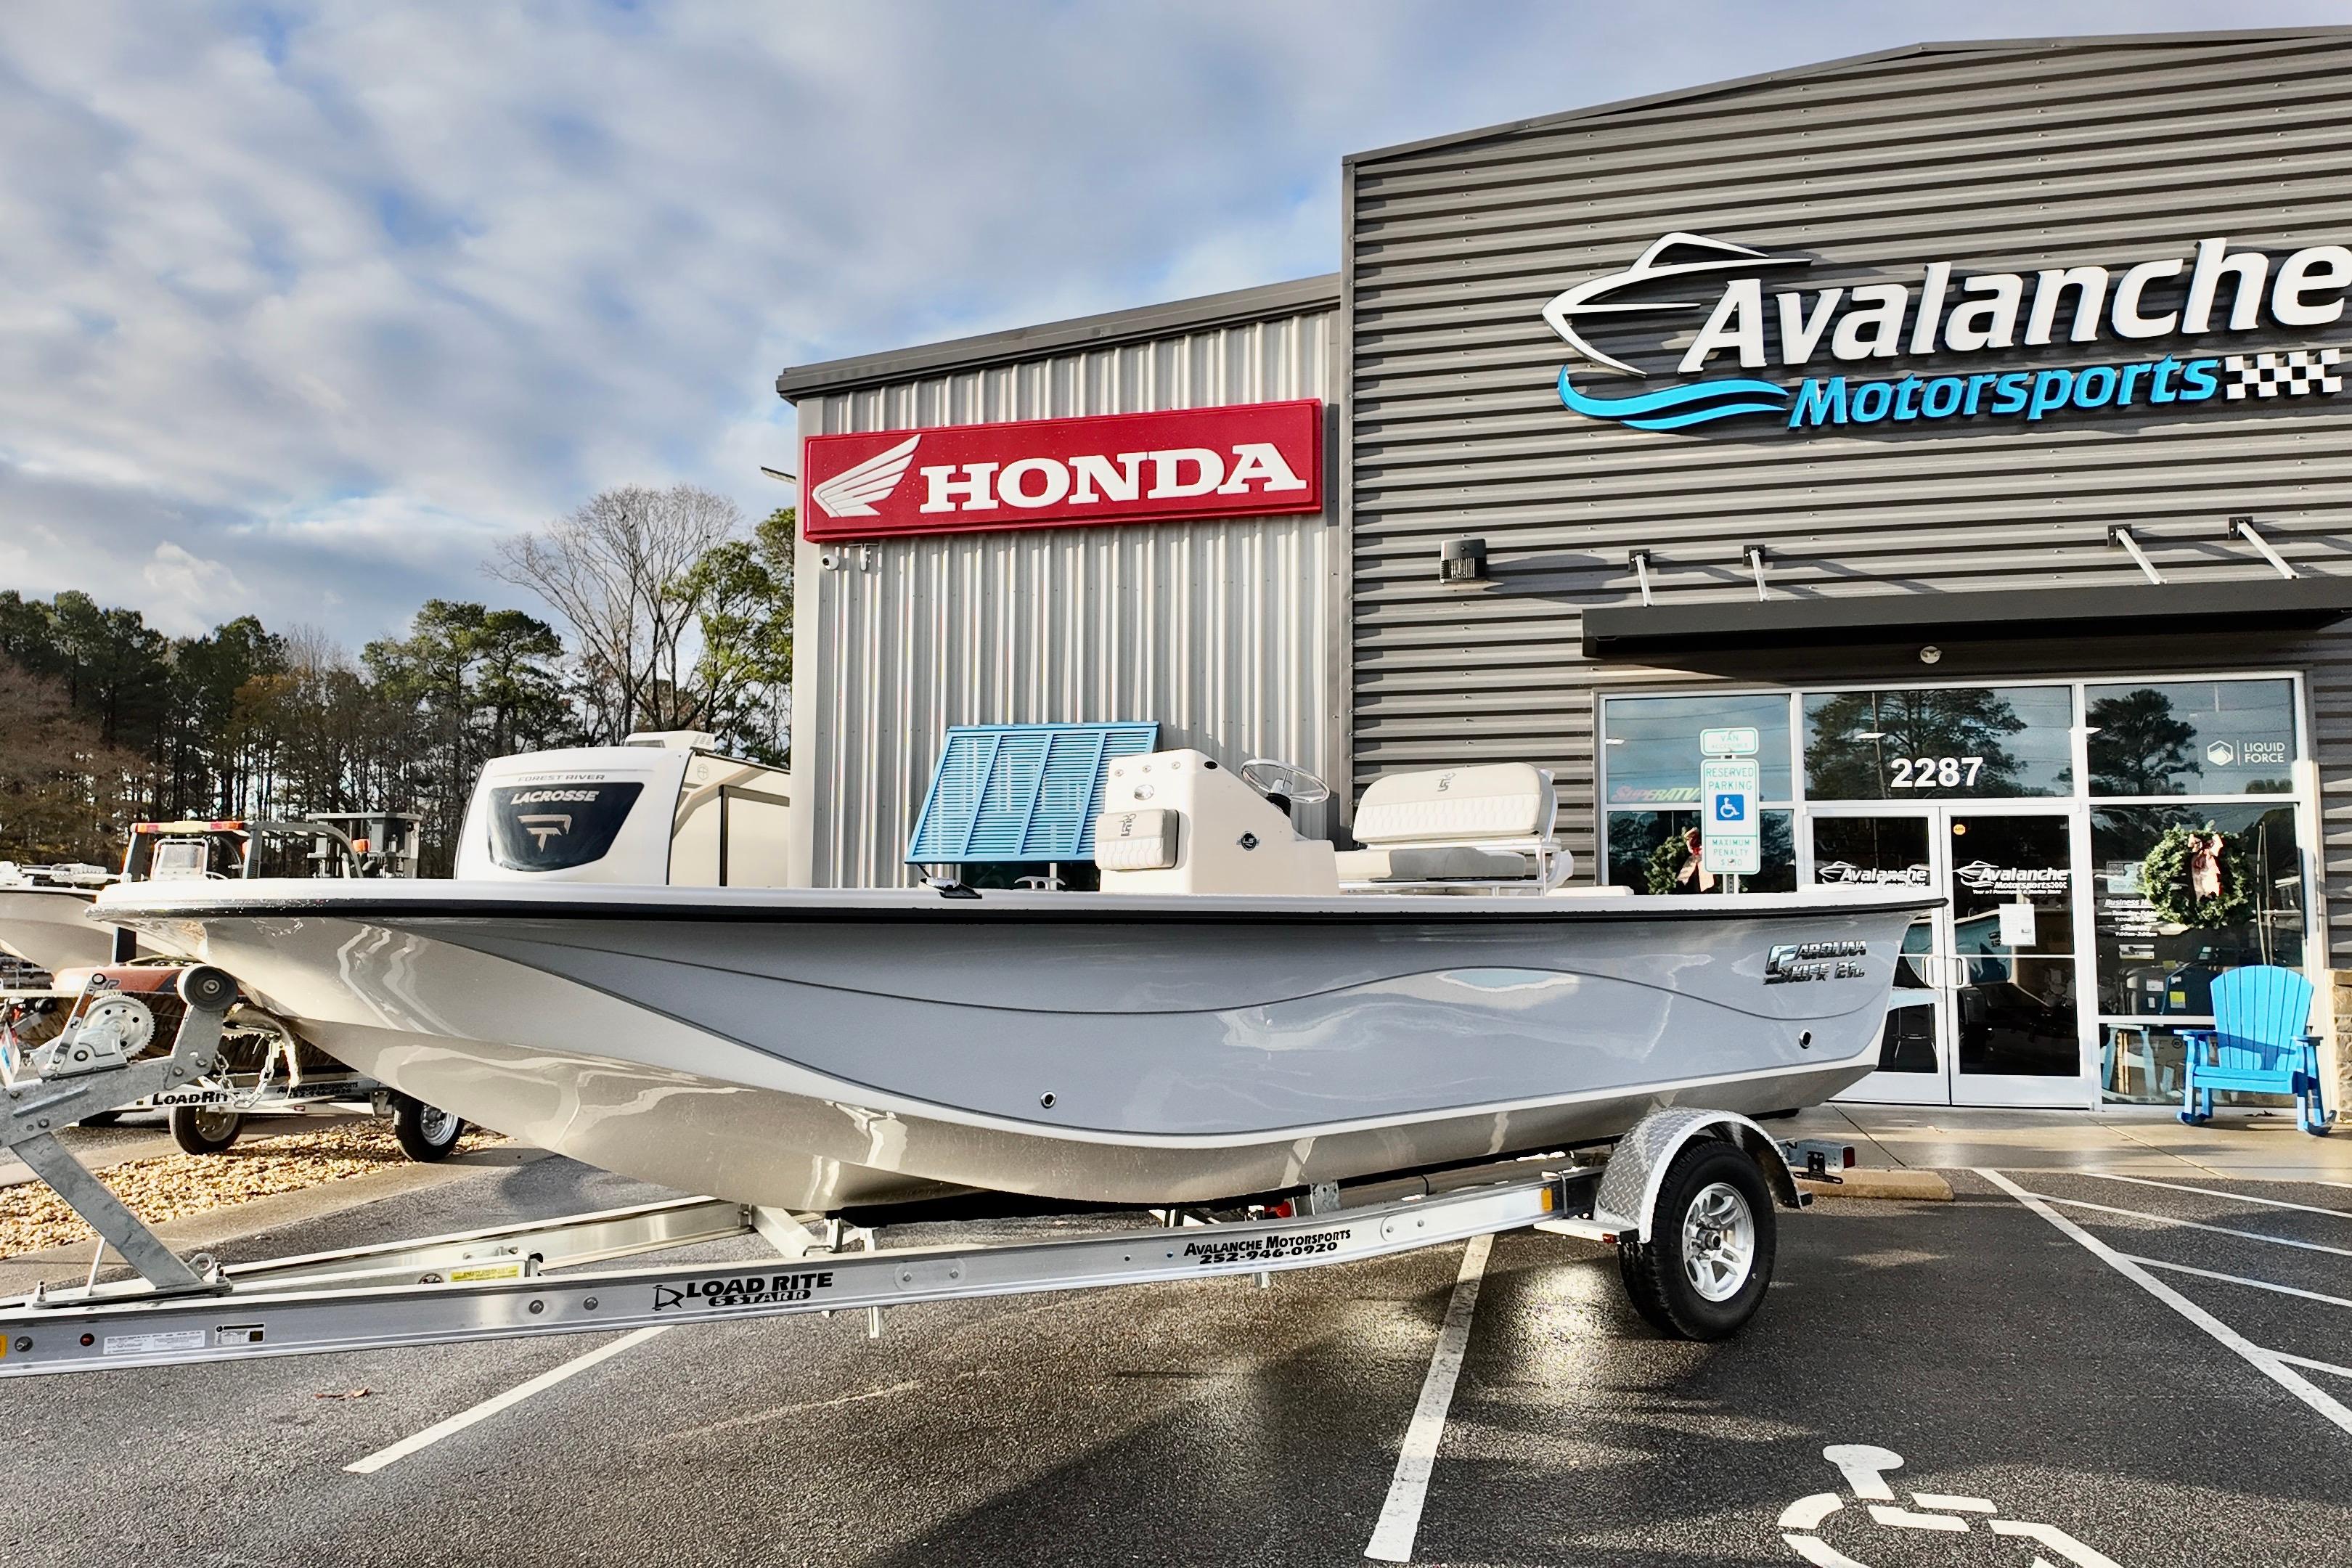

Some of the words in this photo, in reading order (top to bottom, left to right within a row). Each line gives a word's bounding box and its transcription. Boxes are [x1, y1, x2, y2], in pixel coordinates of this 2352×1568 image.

[1676, 237, 2352, 375] Avalanche
[1787, 353, 2220, 429] Motorsports
[919, 442, 1307, 514] HONDA
[2244, 742, 2286, 753] LIQUID
[2245, 753, 2285, 764] FORCE
[1706, 767, 1755, 777] RESERVED
[1890, 756, 1984, 788] 2287
[1708, 780, 1752, 791] PARKING
[510, 790, 600, 805] LACROSSE
[1978, 867, 2067, 881] Avalanche
[1994, 881, 2051, 890] Motorsports
[1199, 1242, 1338, 1265] 252-946-0920
[686, 1278, 765, 1298] LOAD
[771, 1272, 834, 1291] RITE
[714, 1296, 727, 1306] 5
[732, 1290, 806, 1305] STARR
